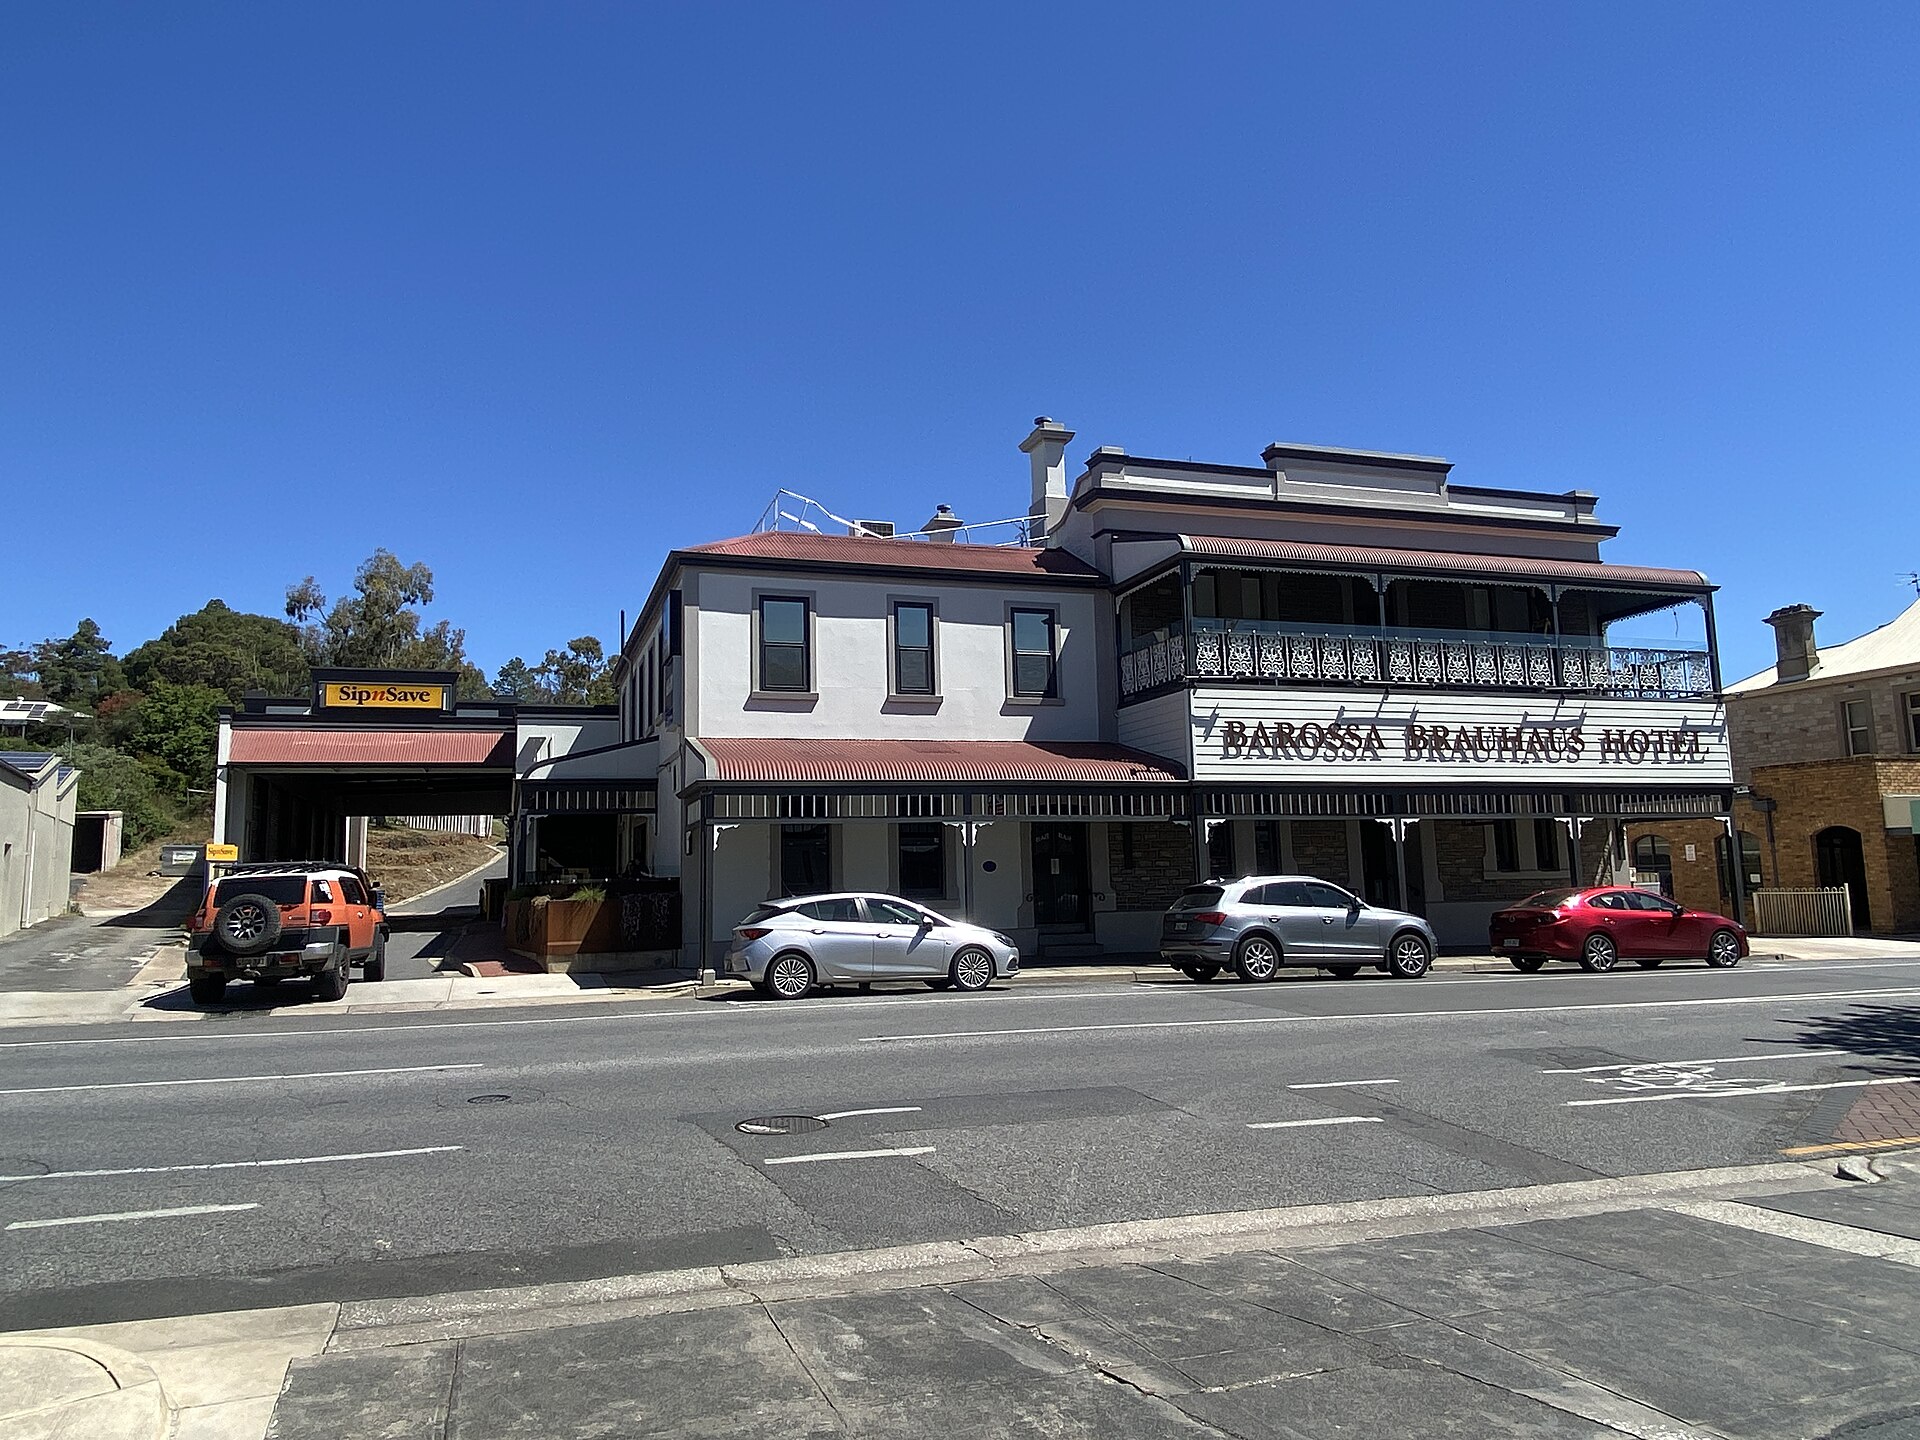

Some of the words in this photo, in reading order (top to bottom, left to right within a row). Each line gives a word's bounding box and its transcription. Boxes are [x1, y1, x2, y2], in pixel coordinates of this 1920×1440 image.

[339, 685, 431, 705] SipnSave
[1224, 720, 1387, 750] BAROSSA
[1406, 724, 1586, 754] BRAUHAUS
[1600, 728, 1710, 755] HOTEL
